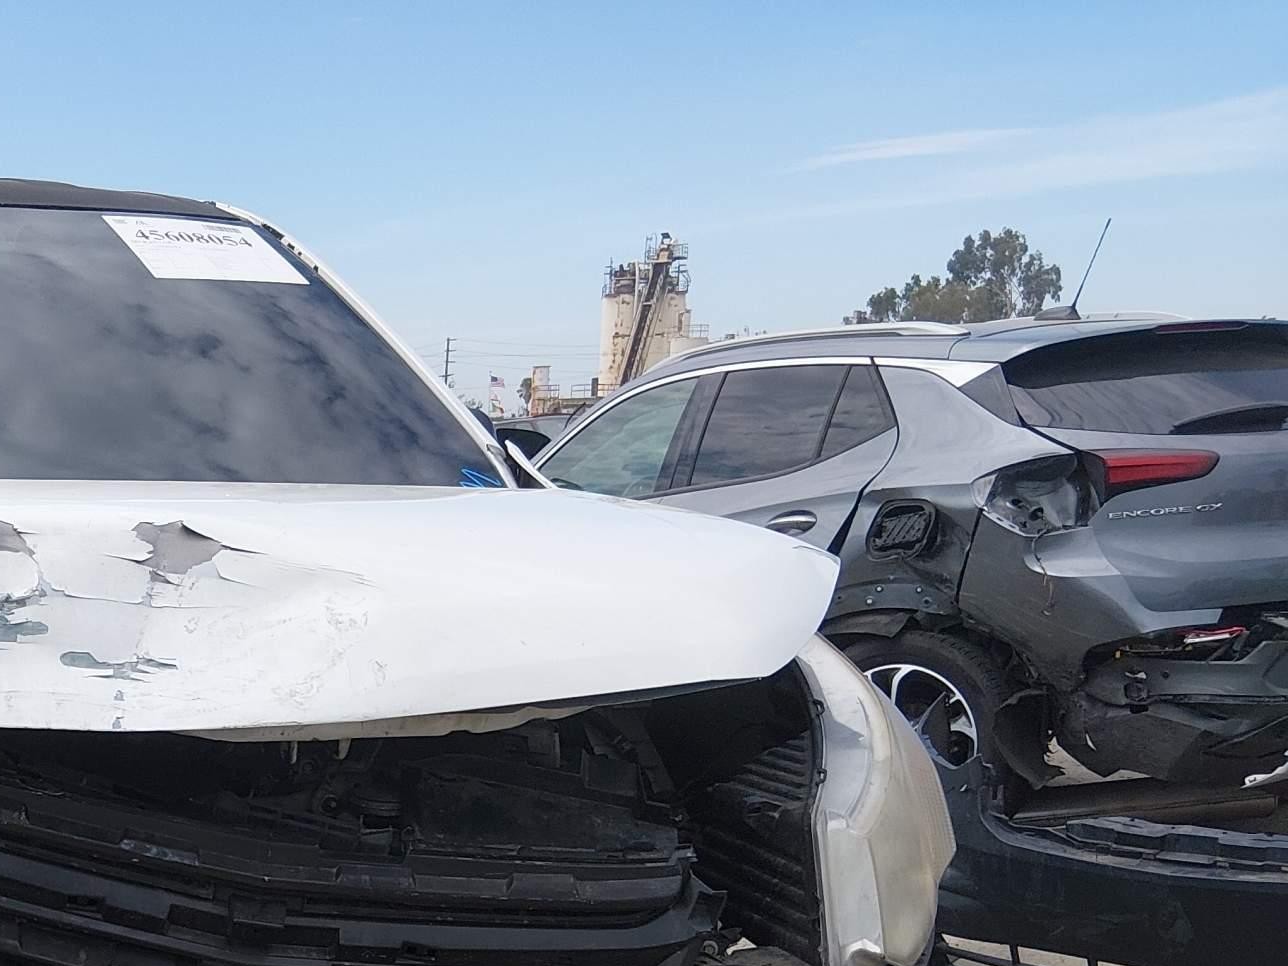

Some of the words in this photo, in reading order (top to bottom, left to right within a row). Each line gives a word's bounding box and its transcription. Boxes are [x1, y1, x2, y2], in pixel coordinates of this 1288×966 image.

[135, 229, 253, 247] 45608054
[1107, 505, 1192, 519] ENCORE
[1196, 502, 1223, 512] GX
